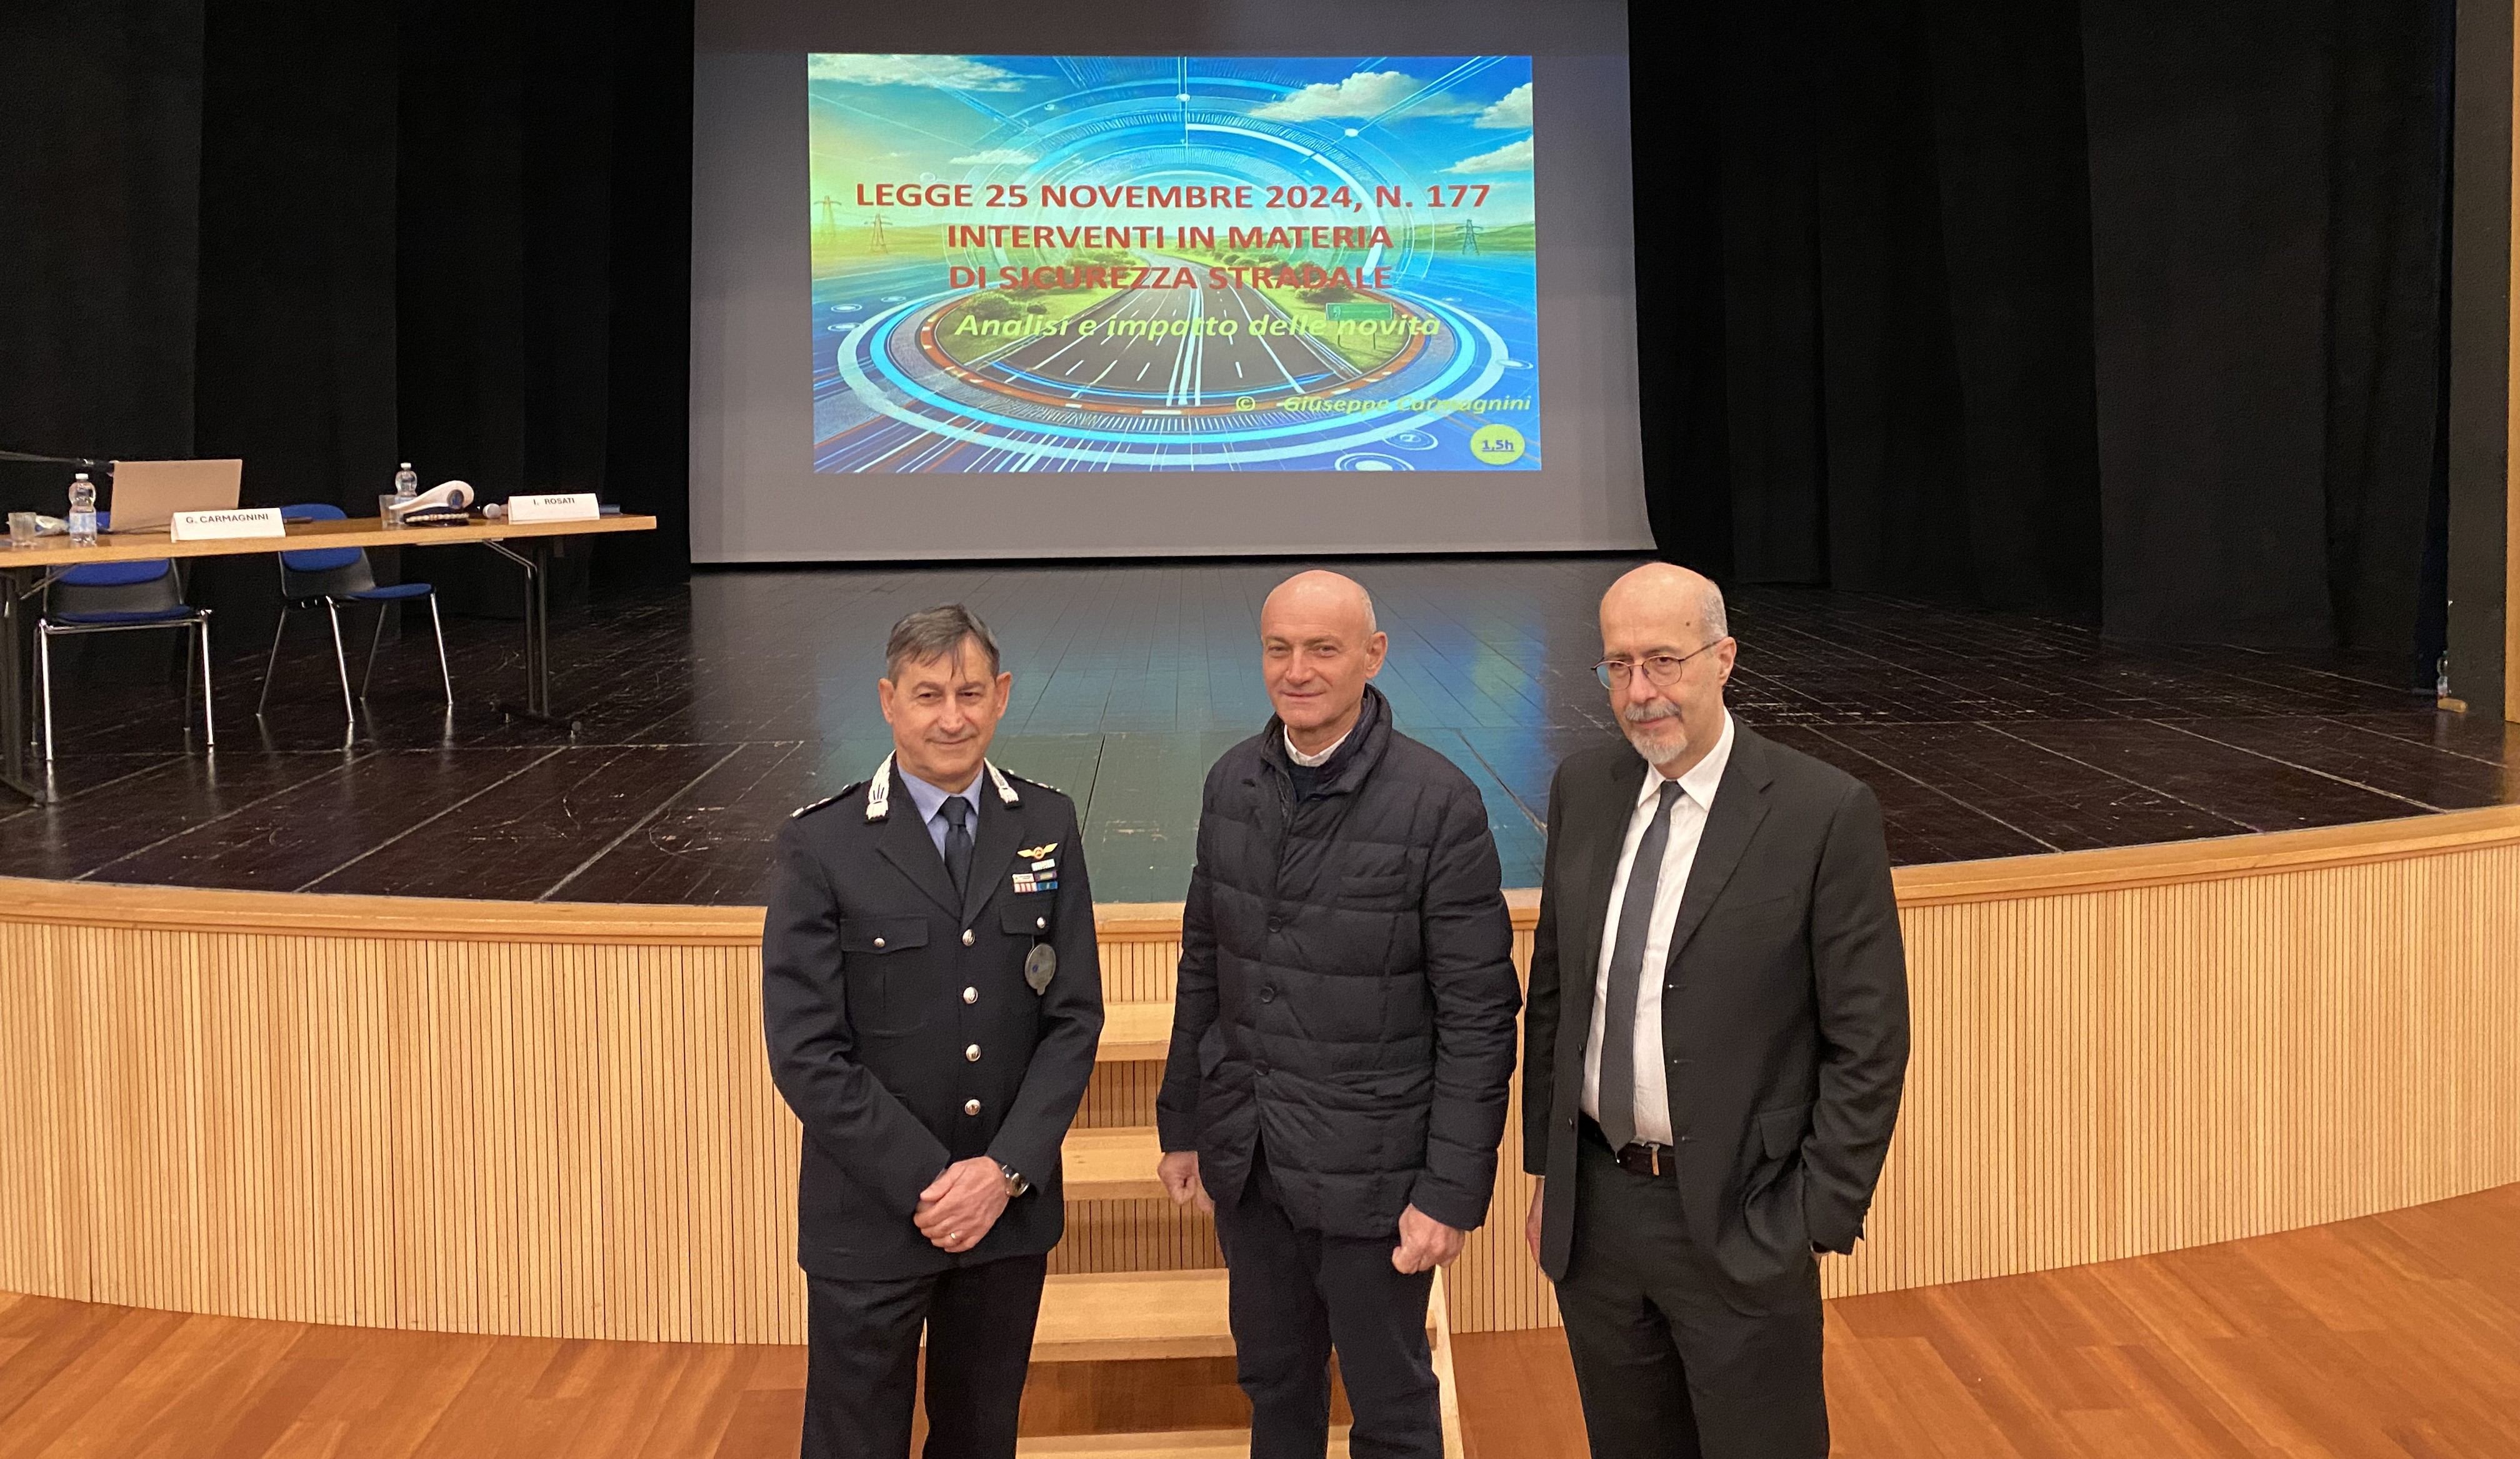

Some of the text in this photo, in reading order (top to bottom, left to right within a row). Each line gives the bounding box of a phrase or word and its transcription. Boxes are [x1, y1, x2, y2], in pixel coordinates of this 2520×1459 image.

[856, 184, 1491, 213] LEGGE 25 NOVEMBRE 2024, N. 177
[948, 225, 1394, 249] INTERVENTI IN MATERIA
[949, 266, 1393, 290] DI SICUREZZA STRADALE
[955, 314, 1440, 341] Analisi e impatto delle novità
[1283, 395, 1389, 415] Giuseppe
[1396, 395, 1531, 411] Carmagnini
[544, 497, 576, 505] ROSATI
[199, 513, 269, 524] CARMAGNINI
